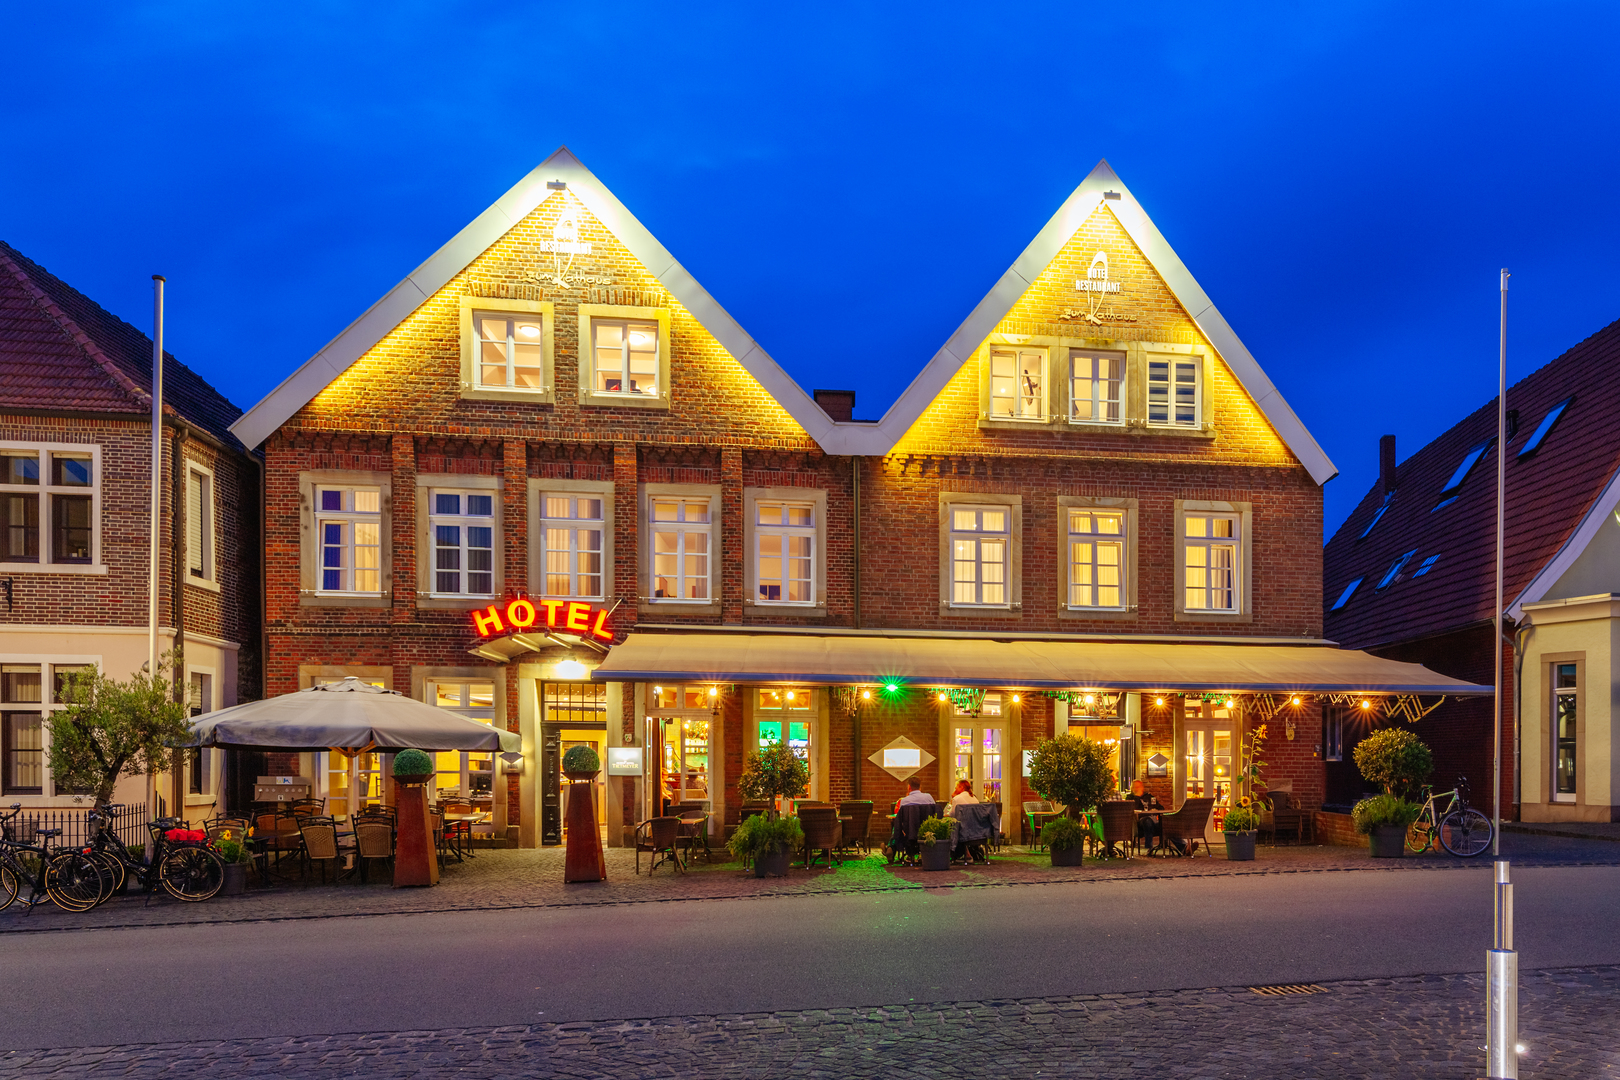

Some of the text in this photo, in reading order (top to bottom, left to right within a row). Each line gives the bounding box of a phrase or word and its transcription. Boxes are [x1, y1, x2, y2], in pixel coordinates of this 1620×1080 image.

[1087, 267, 1109, 279] HOTEL
[1075, 279, 1121, 292] RESTAURANT
[471, 599, 614, 640] HOTEL
